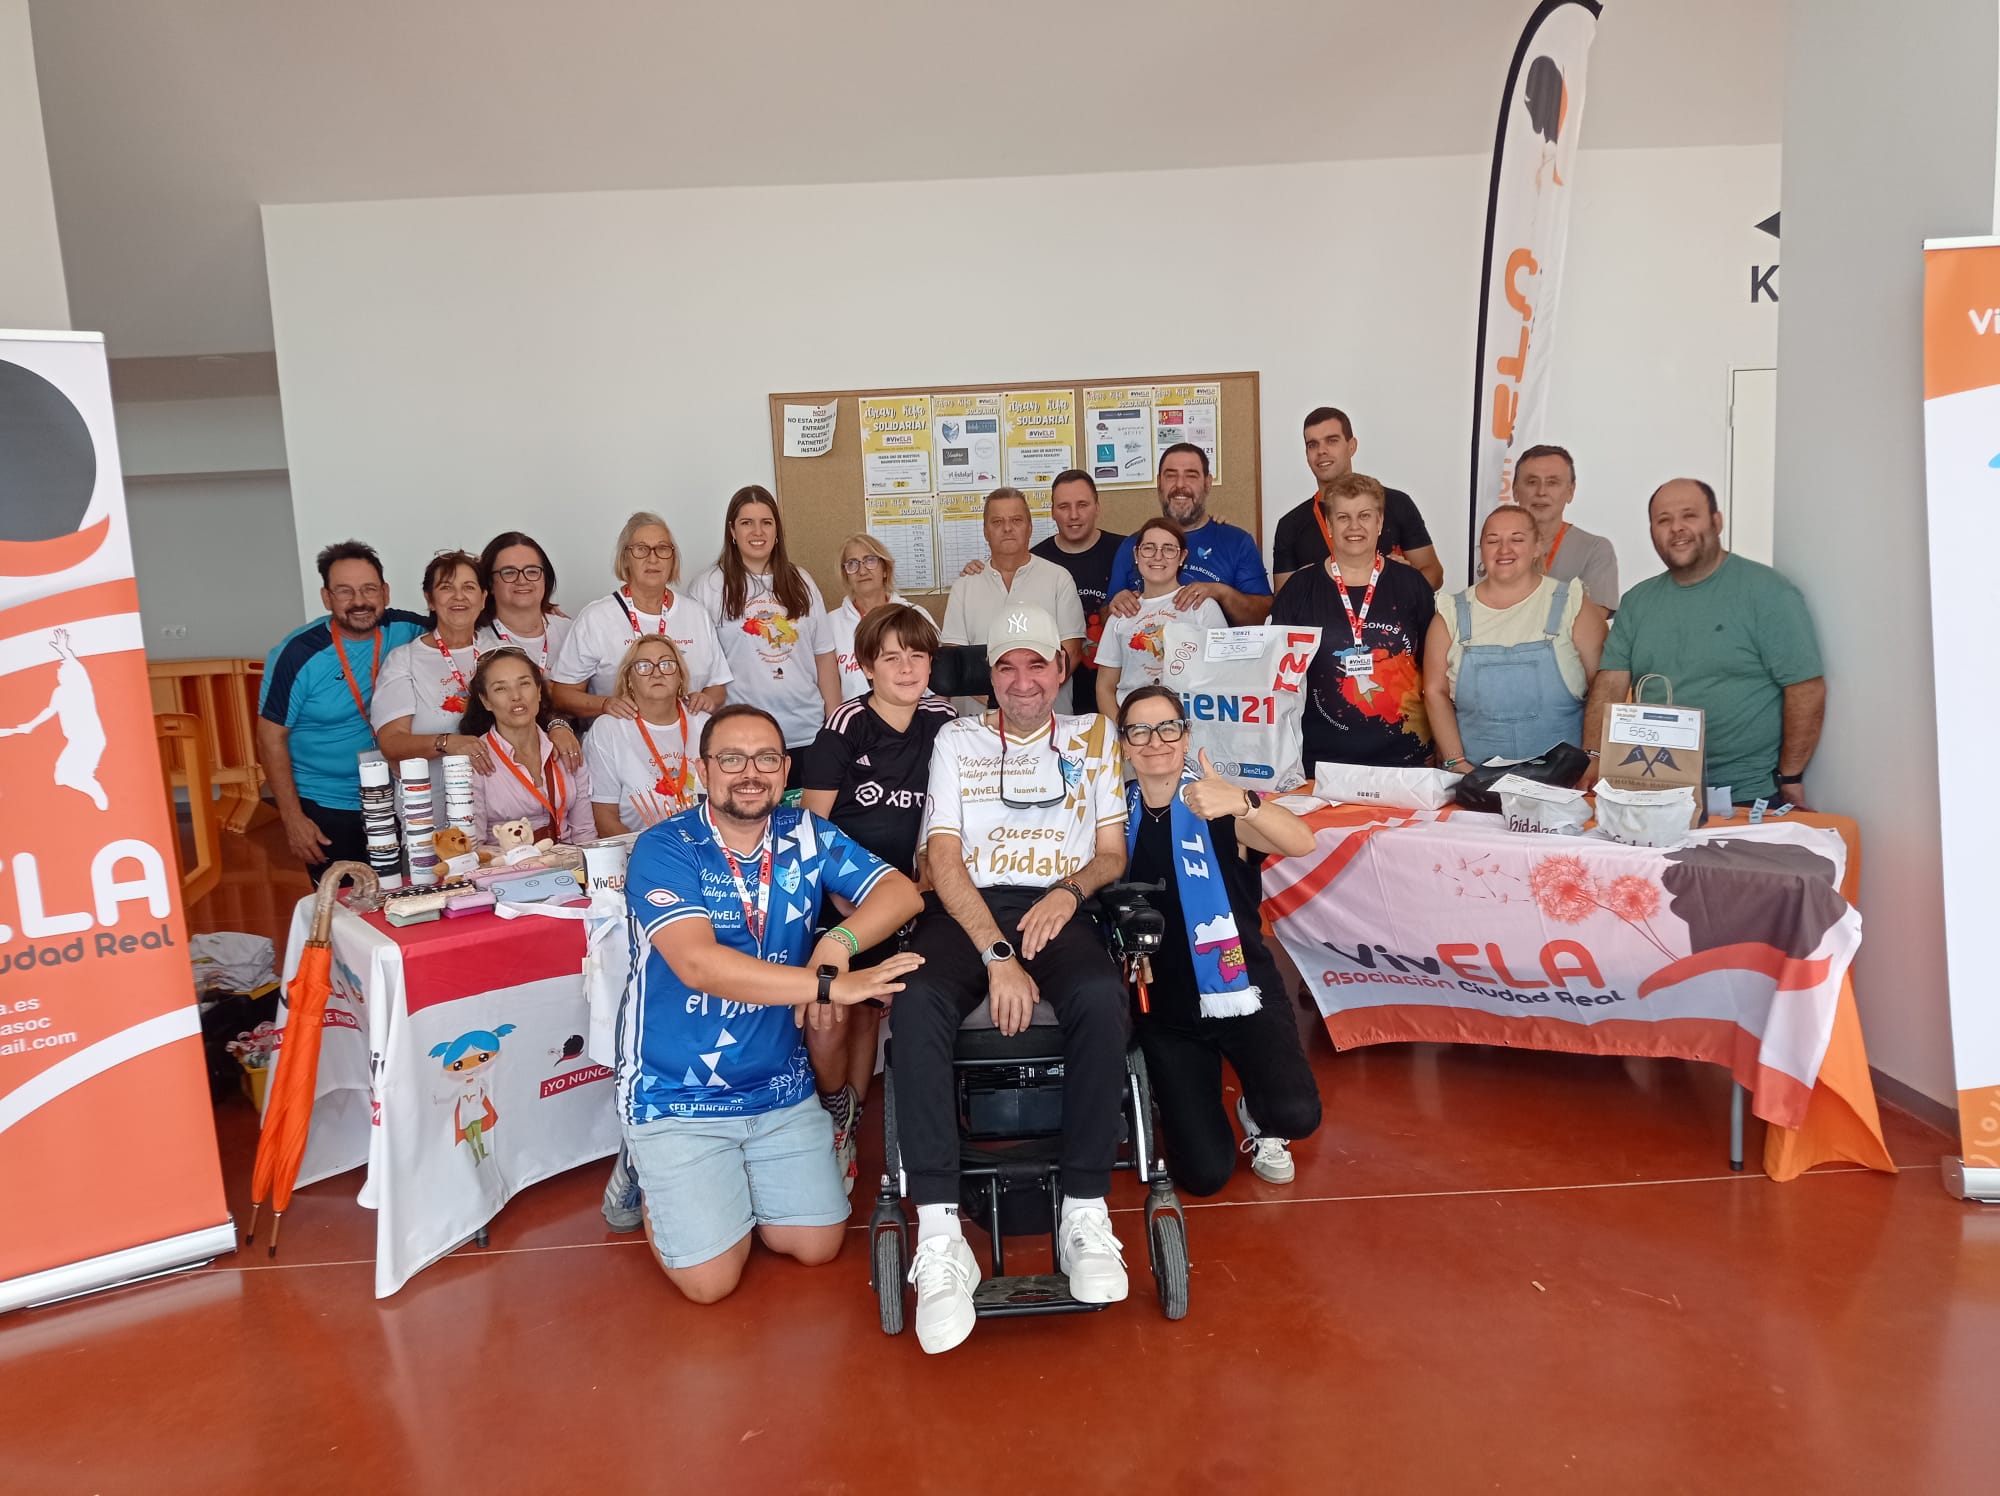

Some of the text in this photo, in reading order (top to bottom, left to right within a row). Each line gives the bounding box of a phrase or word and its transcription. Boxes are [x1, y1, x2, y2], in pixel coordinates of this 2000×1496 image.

[1008, 612, 1029, 634] NY
[1362, 622, 1400, 635] SOMOS
[1243, 768, 1269, 776] tien21.es
[988, 826, 1065, 842] Quesos
[94, 923, 175, 958] Real
[1322, 939, 1606, 989] VivELA
[1322, 970, 1627, 1007] Asociación Ciudad Real
[543, 1077, 566, 1096] ¡YO
